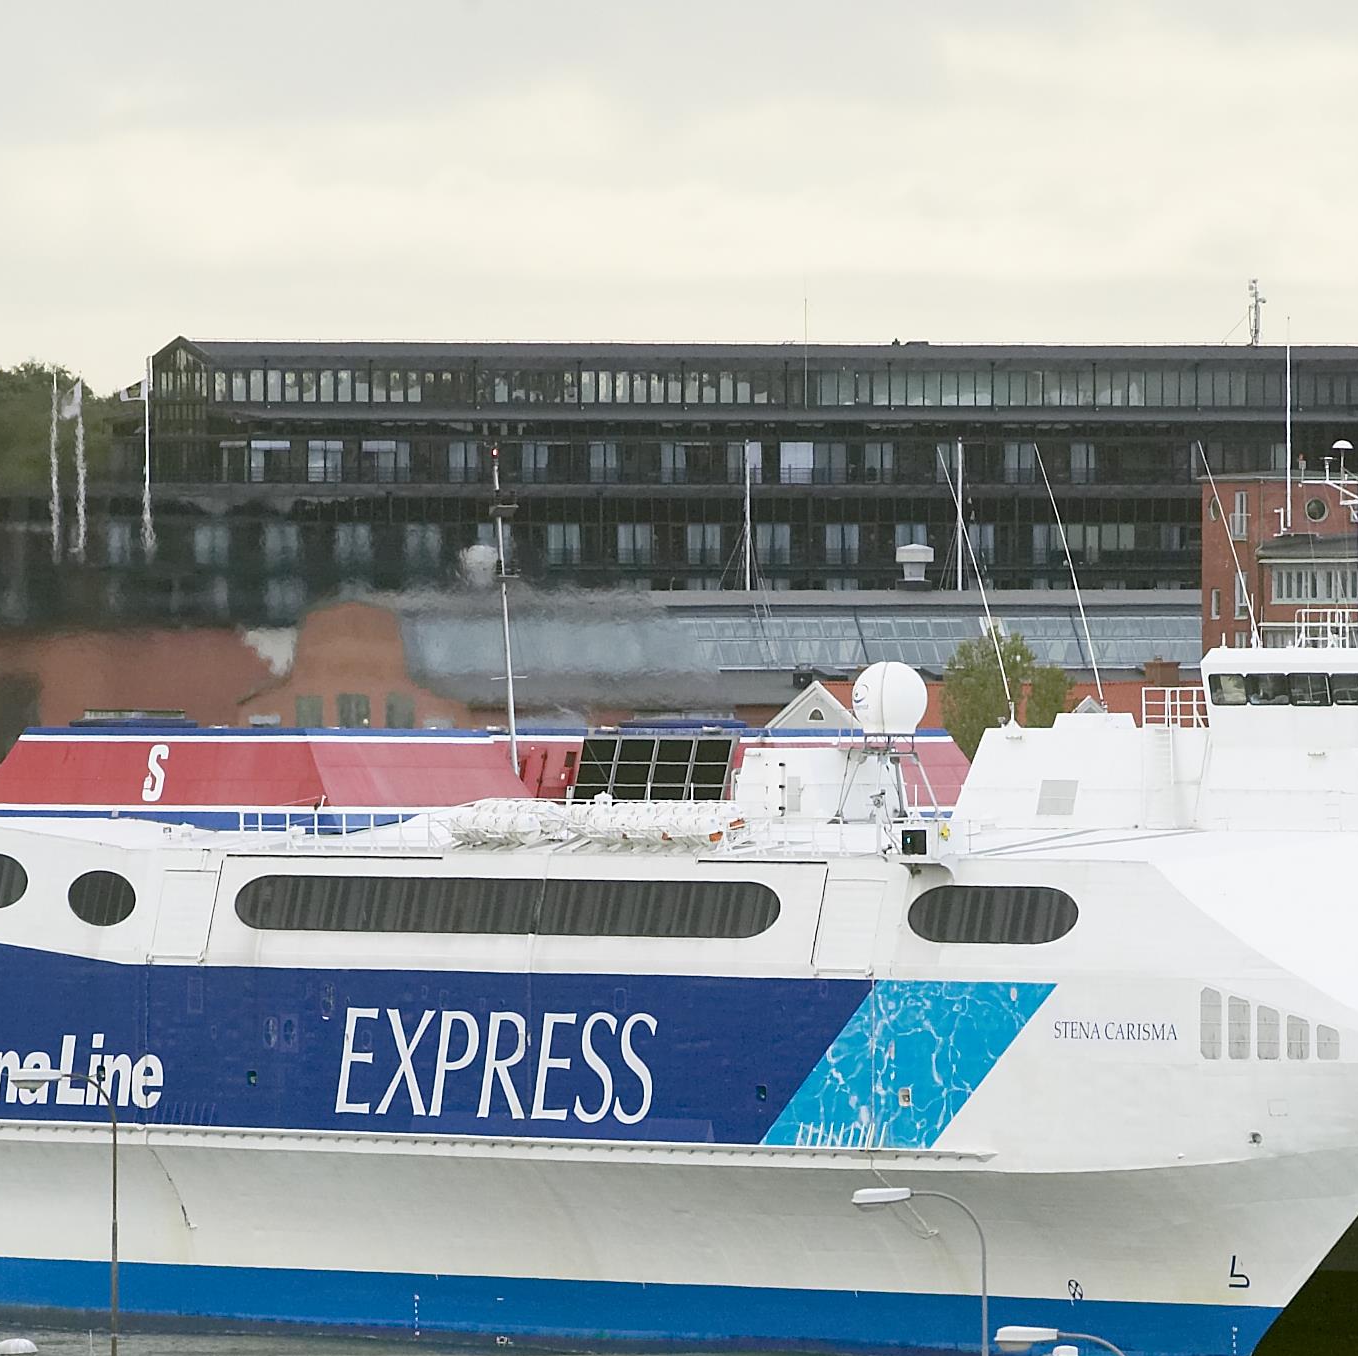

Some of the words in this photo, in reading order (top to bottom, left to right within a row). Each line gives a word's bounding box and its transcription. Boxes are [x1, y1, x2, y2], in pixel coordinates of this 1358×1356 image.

[142, 744, 170, 801] S
[1054, 1021, 1101, 1040] STENA
[1104, 1022, 1178, 1041] CARISMA
[55, 1033, 164, 1109] Line
[335, 1007, 658, 1124] EXPRESS
